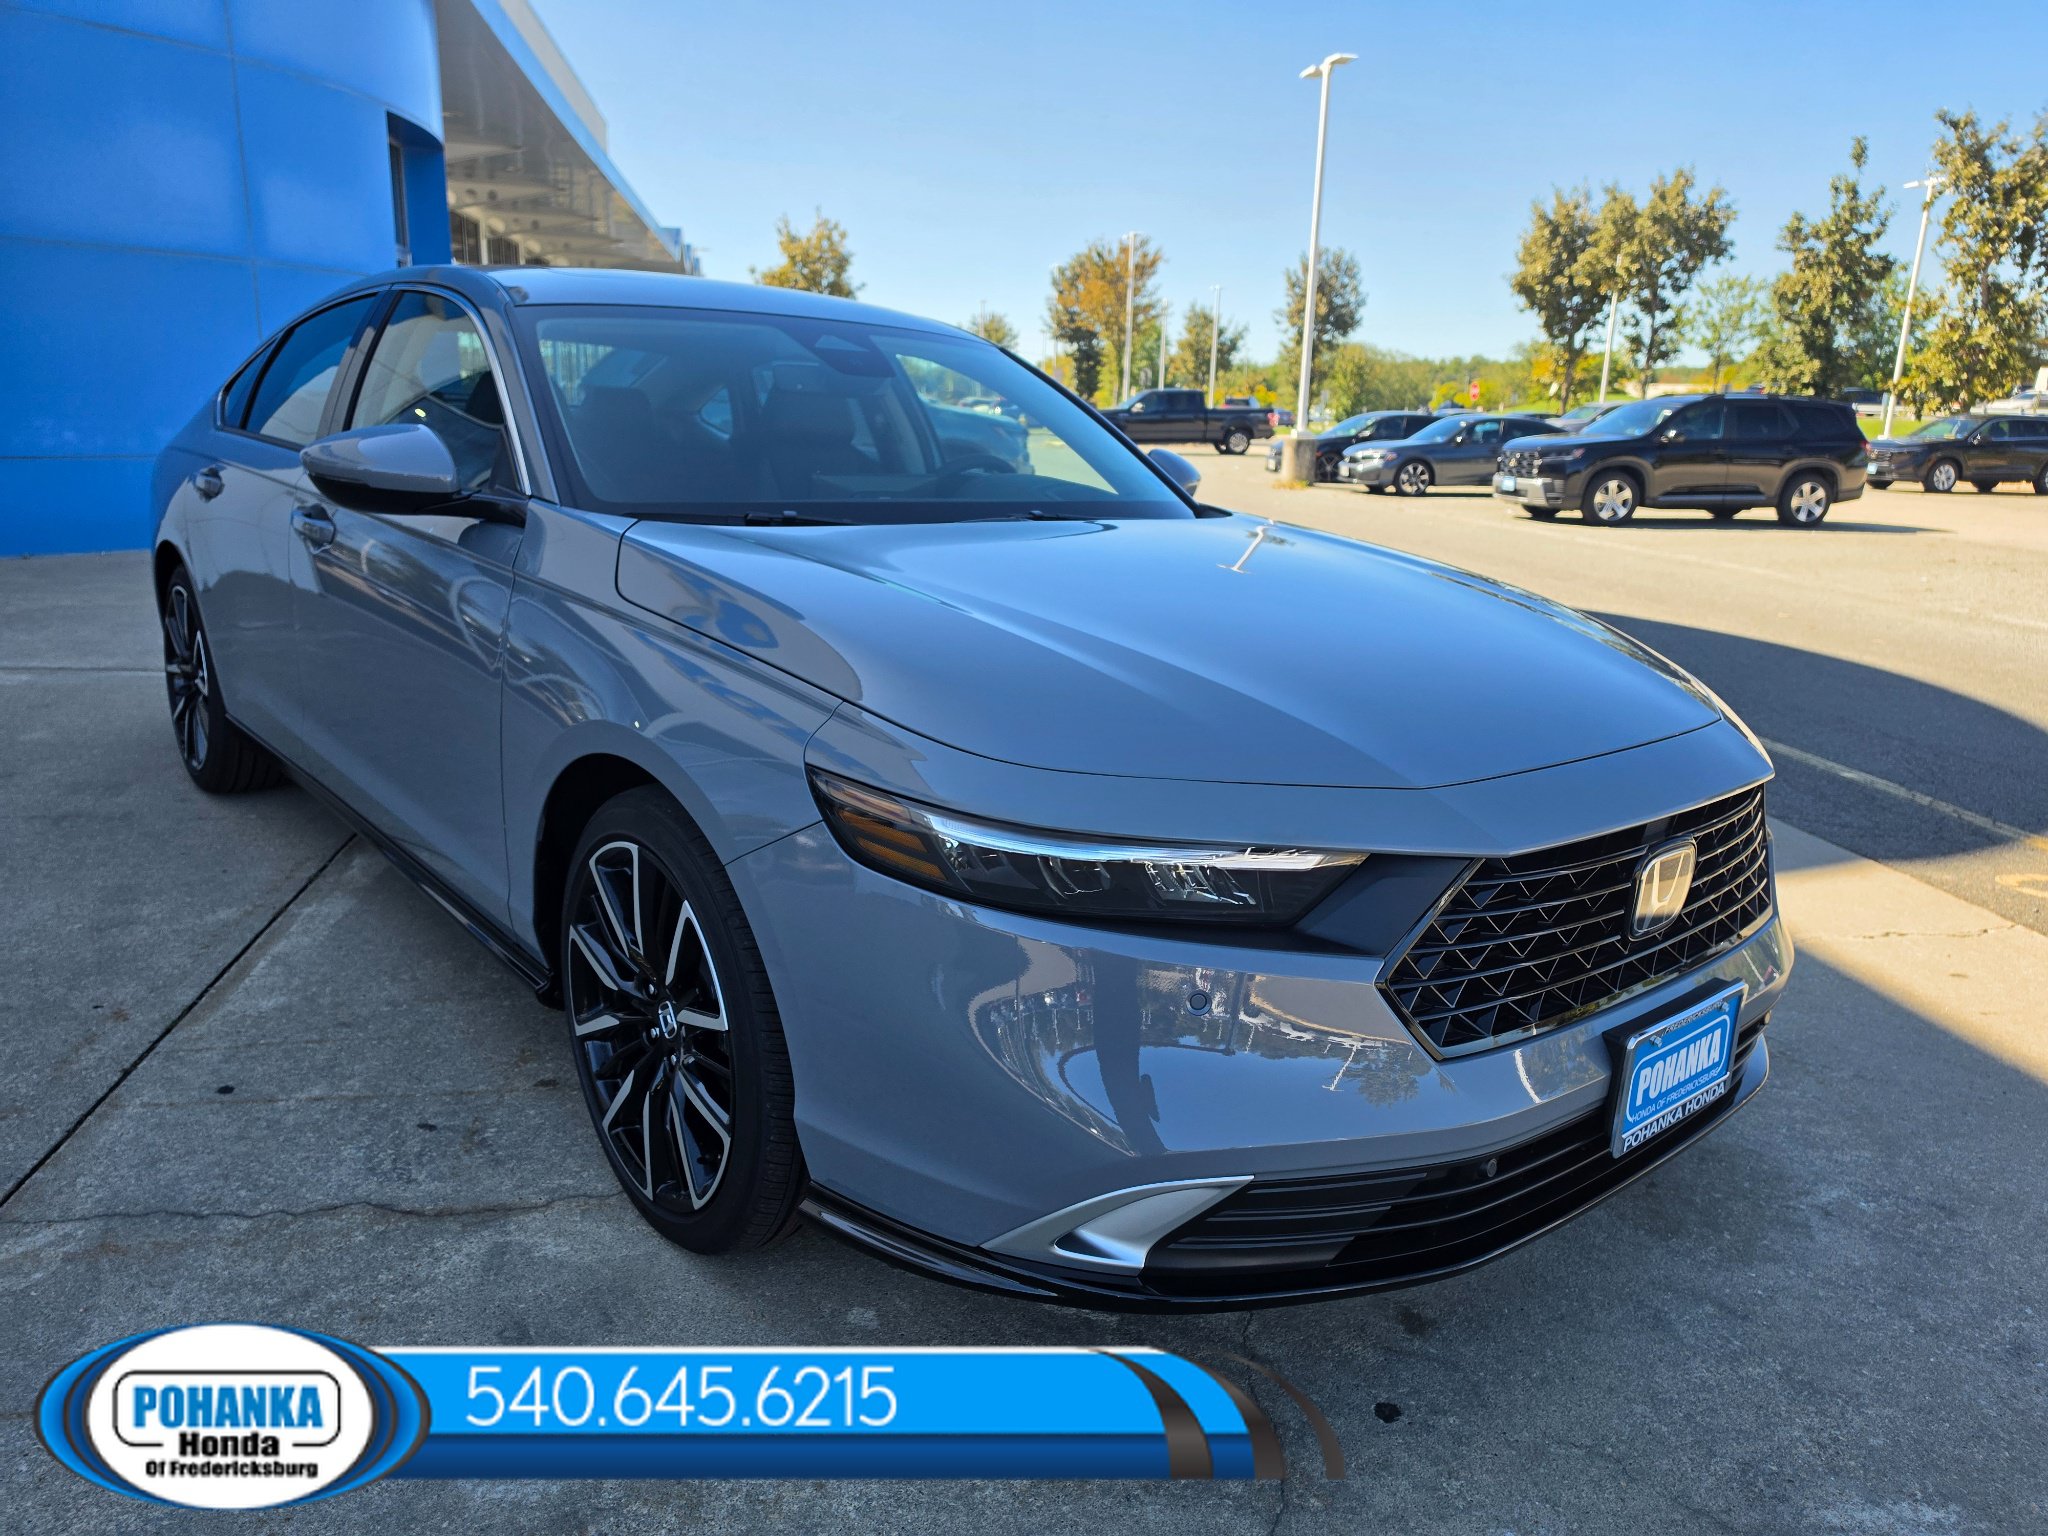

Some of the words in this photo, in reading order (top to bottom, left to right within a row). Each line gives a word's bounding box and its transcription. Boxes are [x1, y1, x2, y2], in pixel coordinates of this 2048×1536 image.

[1632, 1104, 1656, 1123] HONDA
[1656, 1097, 1667, 1110] OF
[1667, 1068, 1720, 1103] FREDERICKSBURG
[1636, 1028, 1721, 1106] POHANKA
[1623, 1108, 1683, 1153] POHANKA
[1685, 1083, 1725, 1115] HONDA
